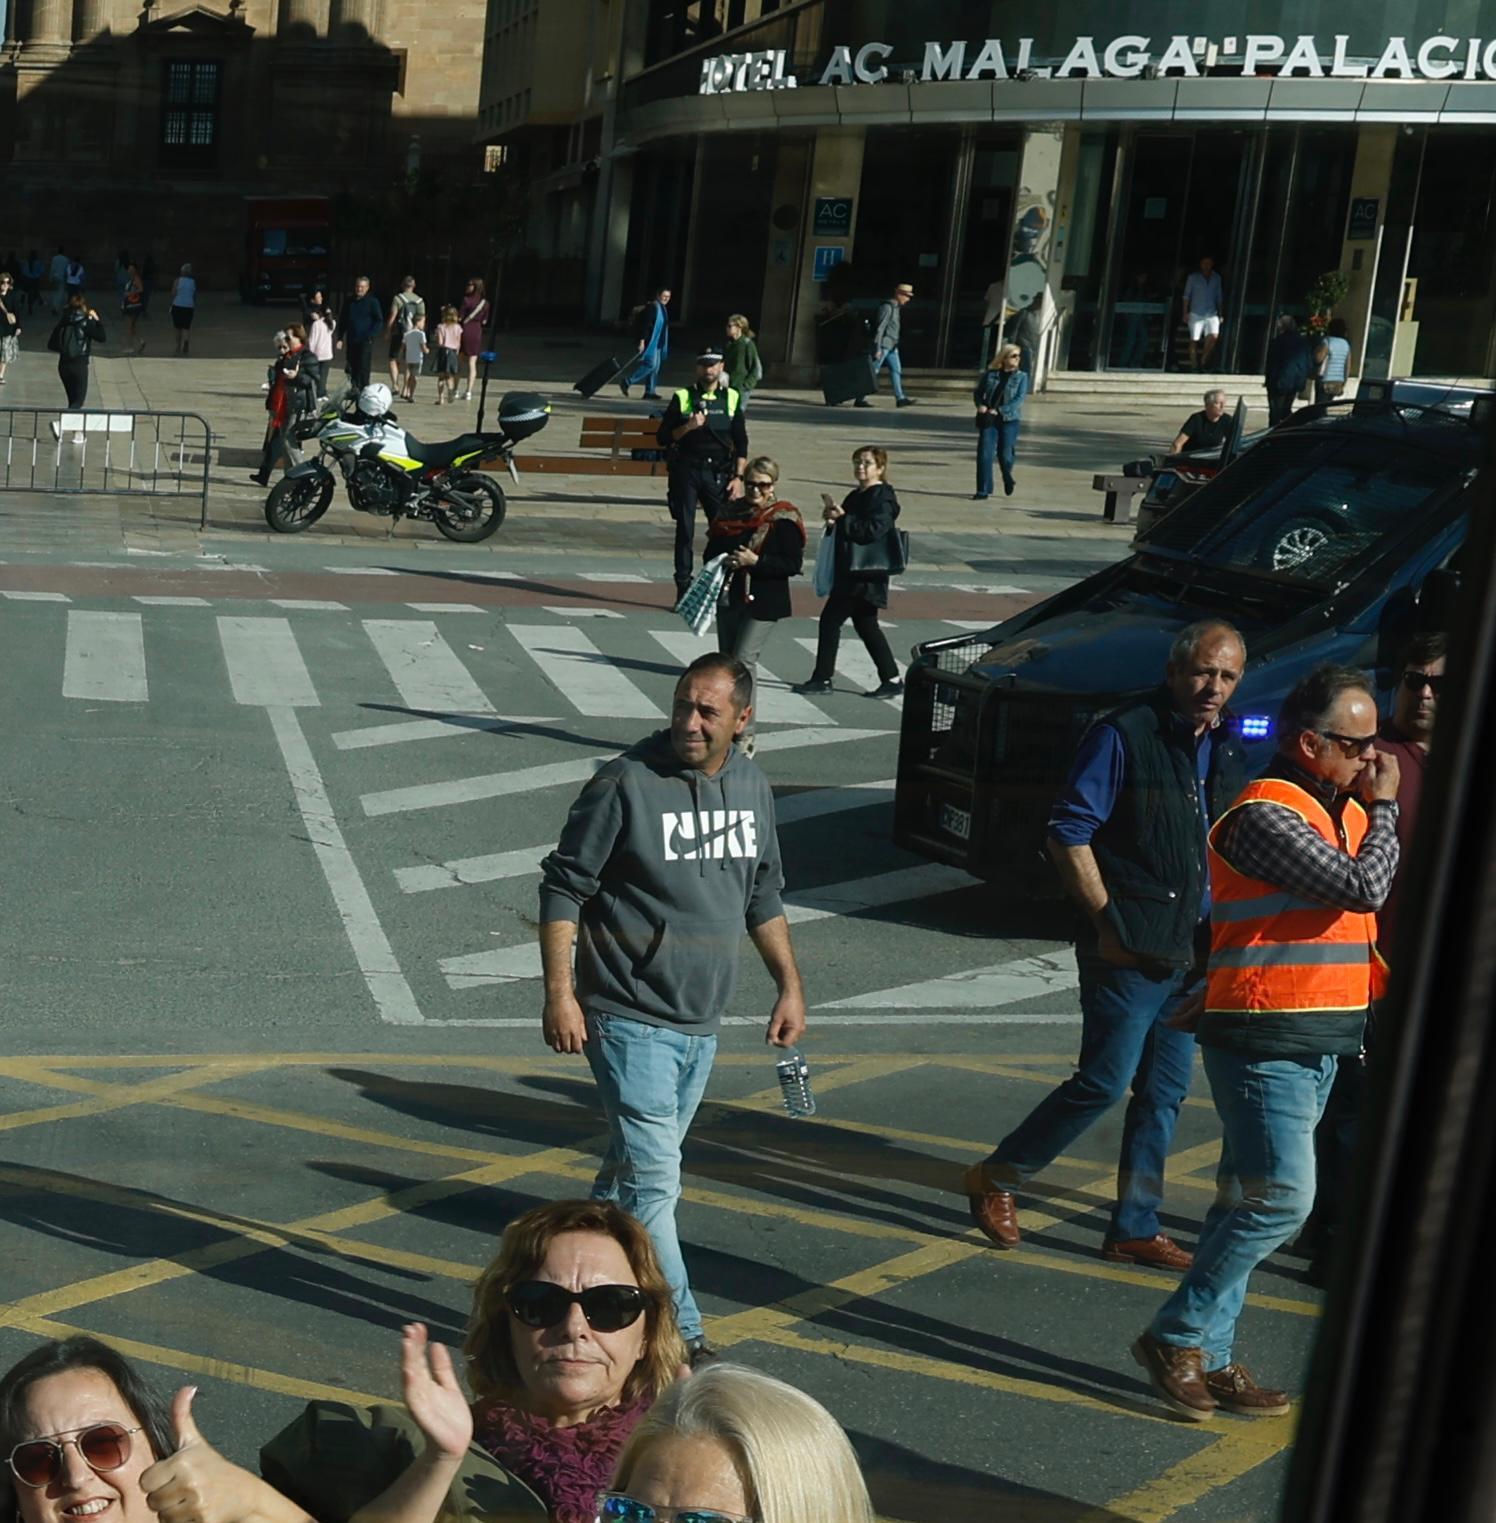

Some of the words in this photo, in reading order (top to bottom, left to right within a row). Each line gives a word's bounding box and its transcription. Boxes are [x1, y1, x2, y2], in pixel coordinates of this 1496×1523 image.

[818, 42, 894, 86] AC
[920, 35, 1200, 82] MALAGA
[819, 203, 848, 218] AC
[662, 810, 758, 861] NIKE
